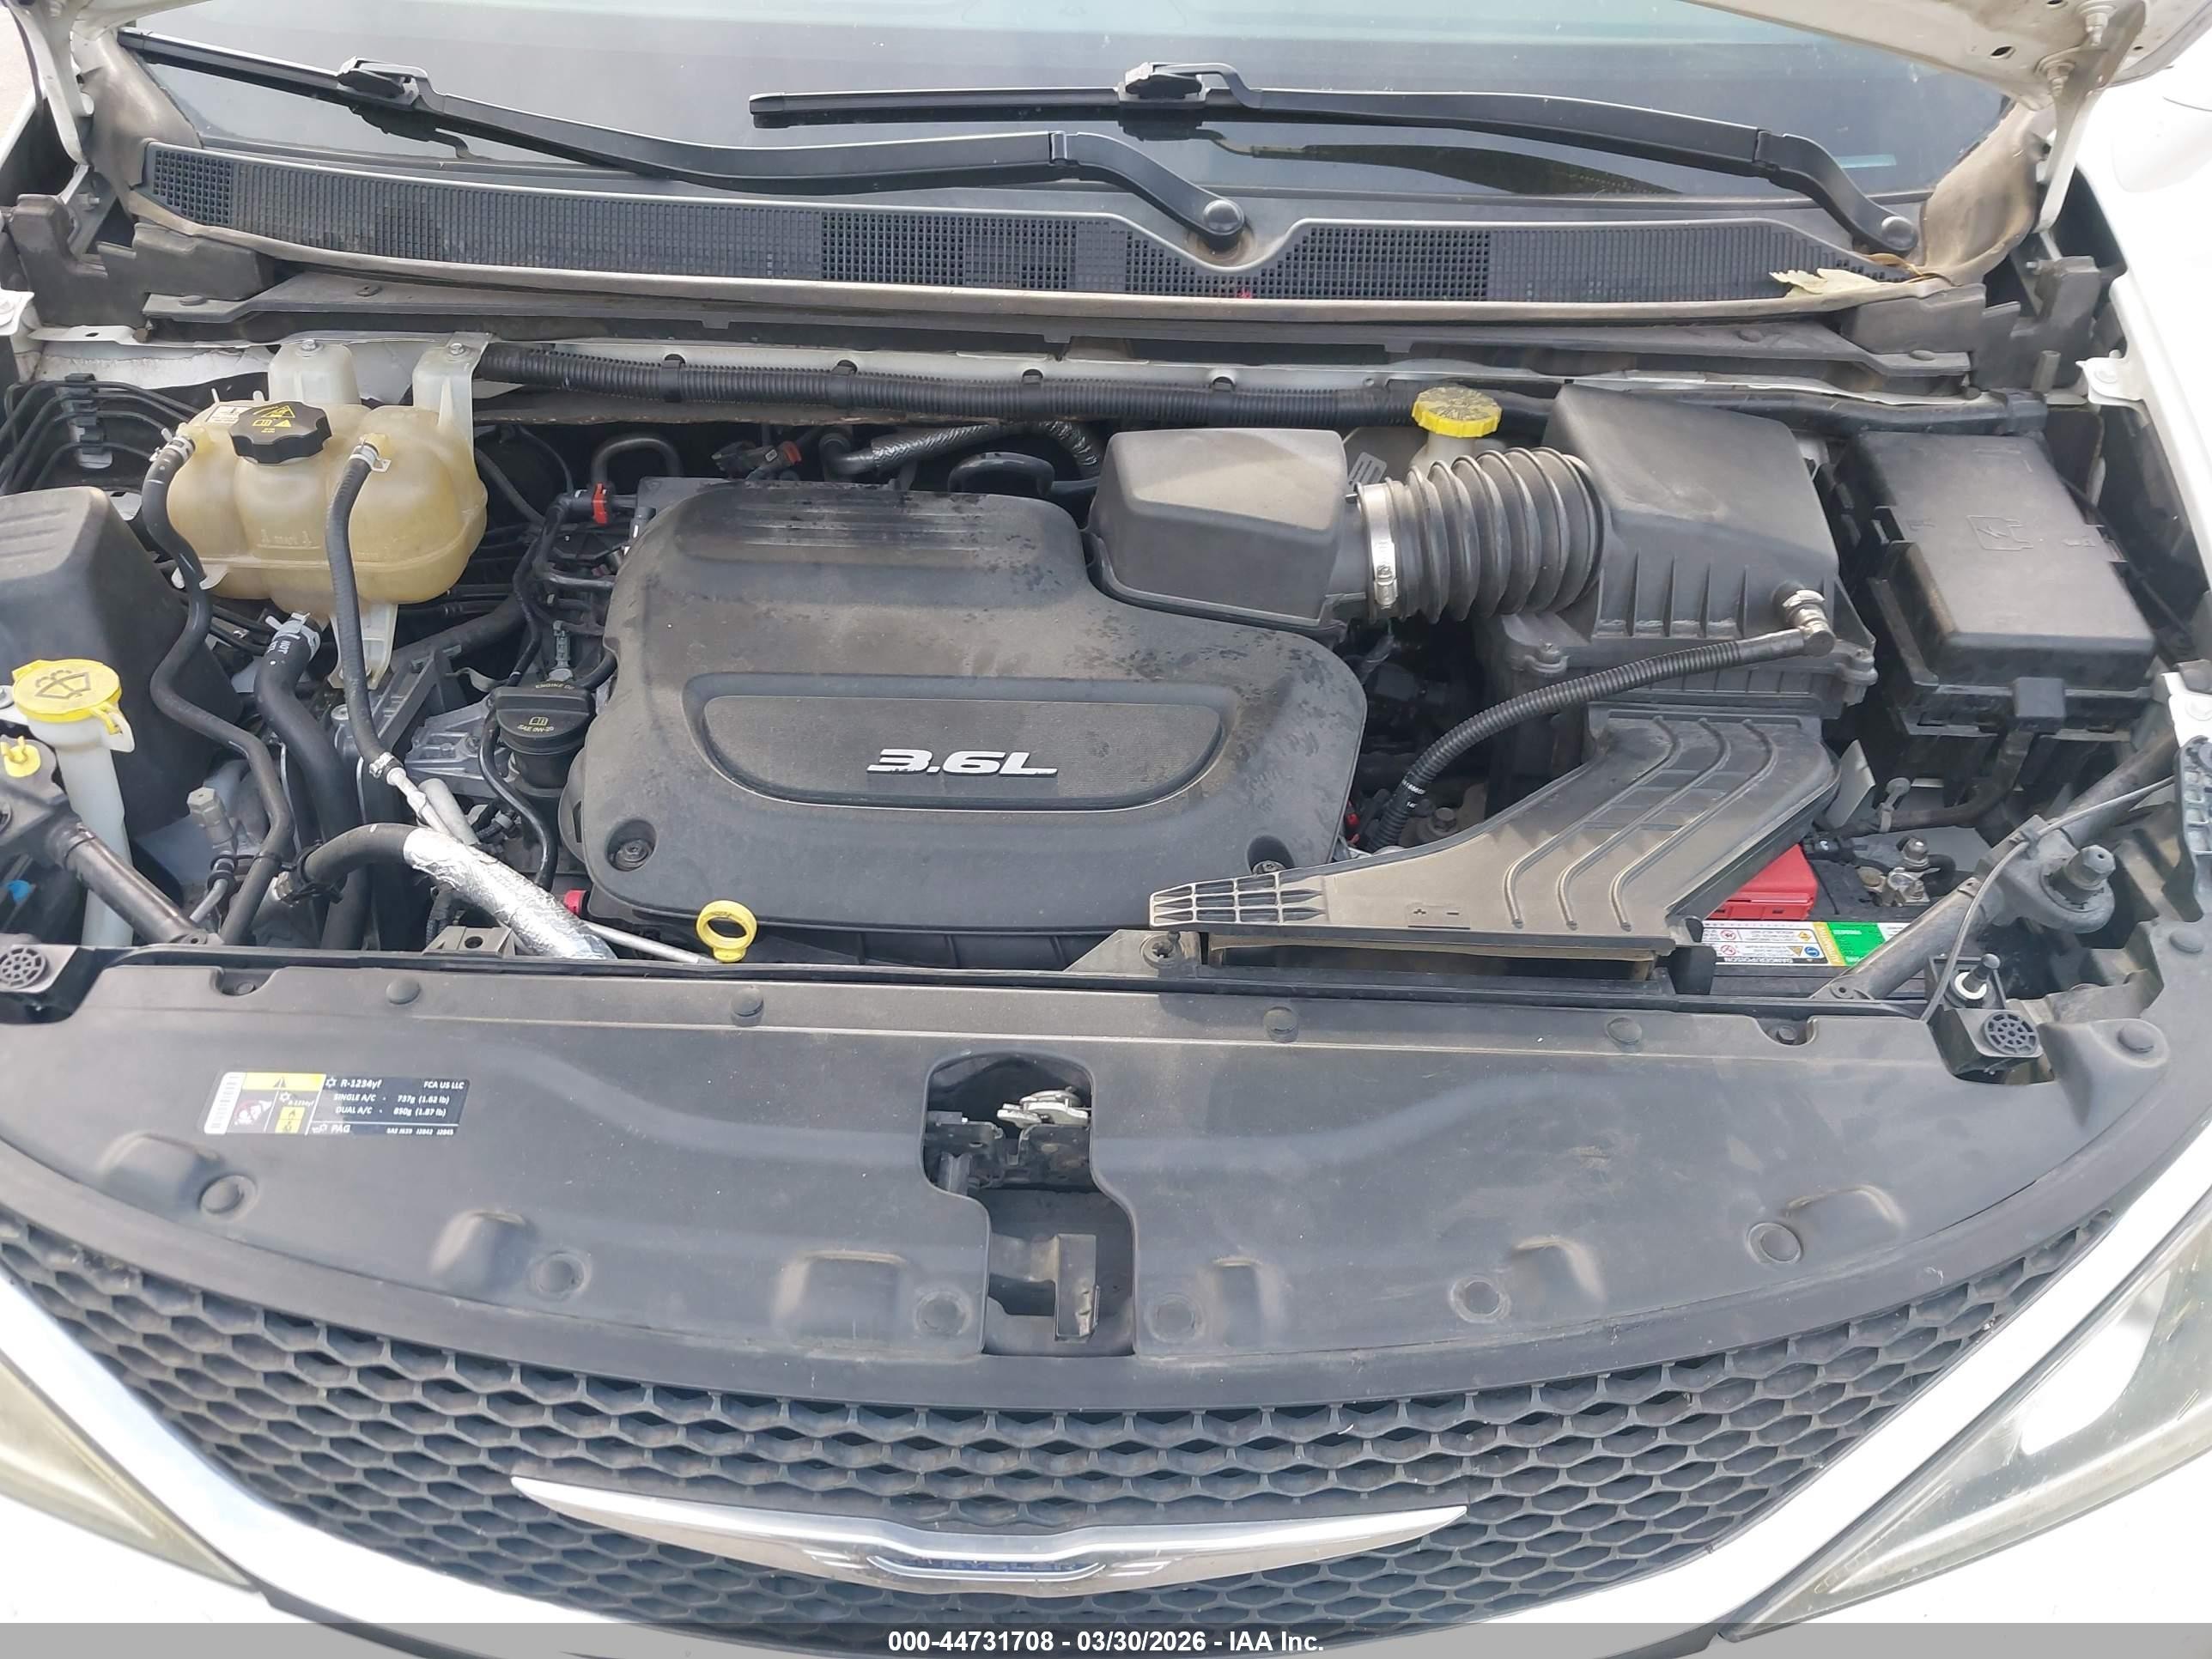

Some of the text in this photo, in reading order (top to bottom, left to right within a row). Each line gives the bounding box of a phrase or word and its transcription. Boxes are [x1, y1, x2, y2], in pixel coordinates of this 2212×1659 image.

[866, 748, 1059, 777] 3.6L
[340, 1079, 382, 1091] R-1234yf
[423, 1080, 465, 1090] FCA US LLC
[361, 1093, 377, 1103] A/C
[356, 1106, 373, 1115] A/C
[331, 1124, 350, 1134] PAG
